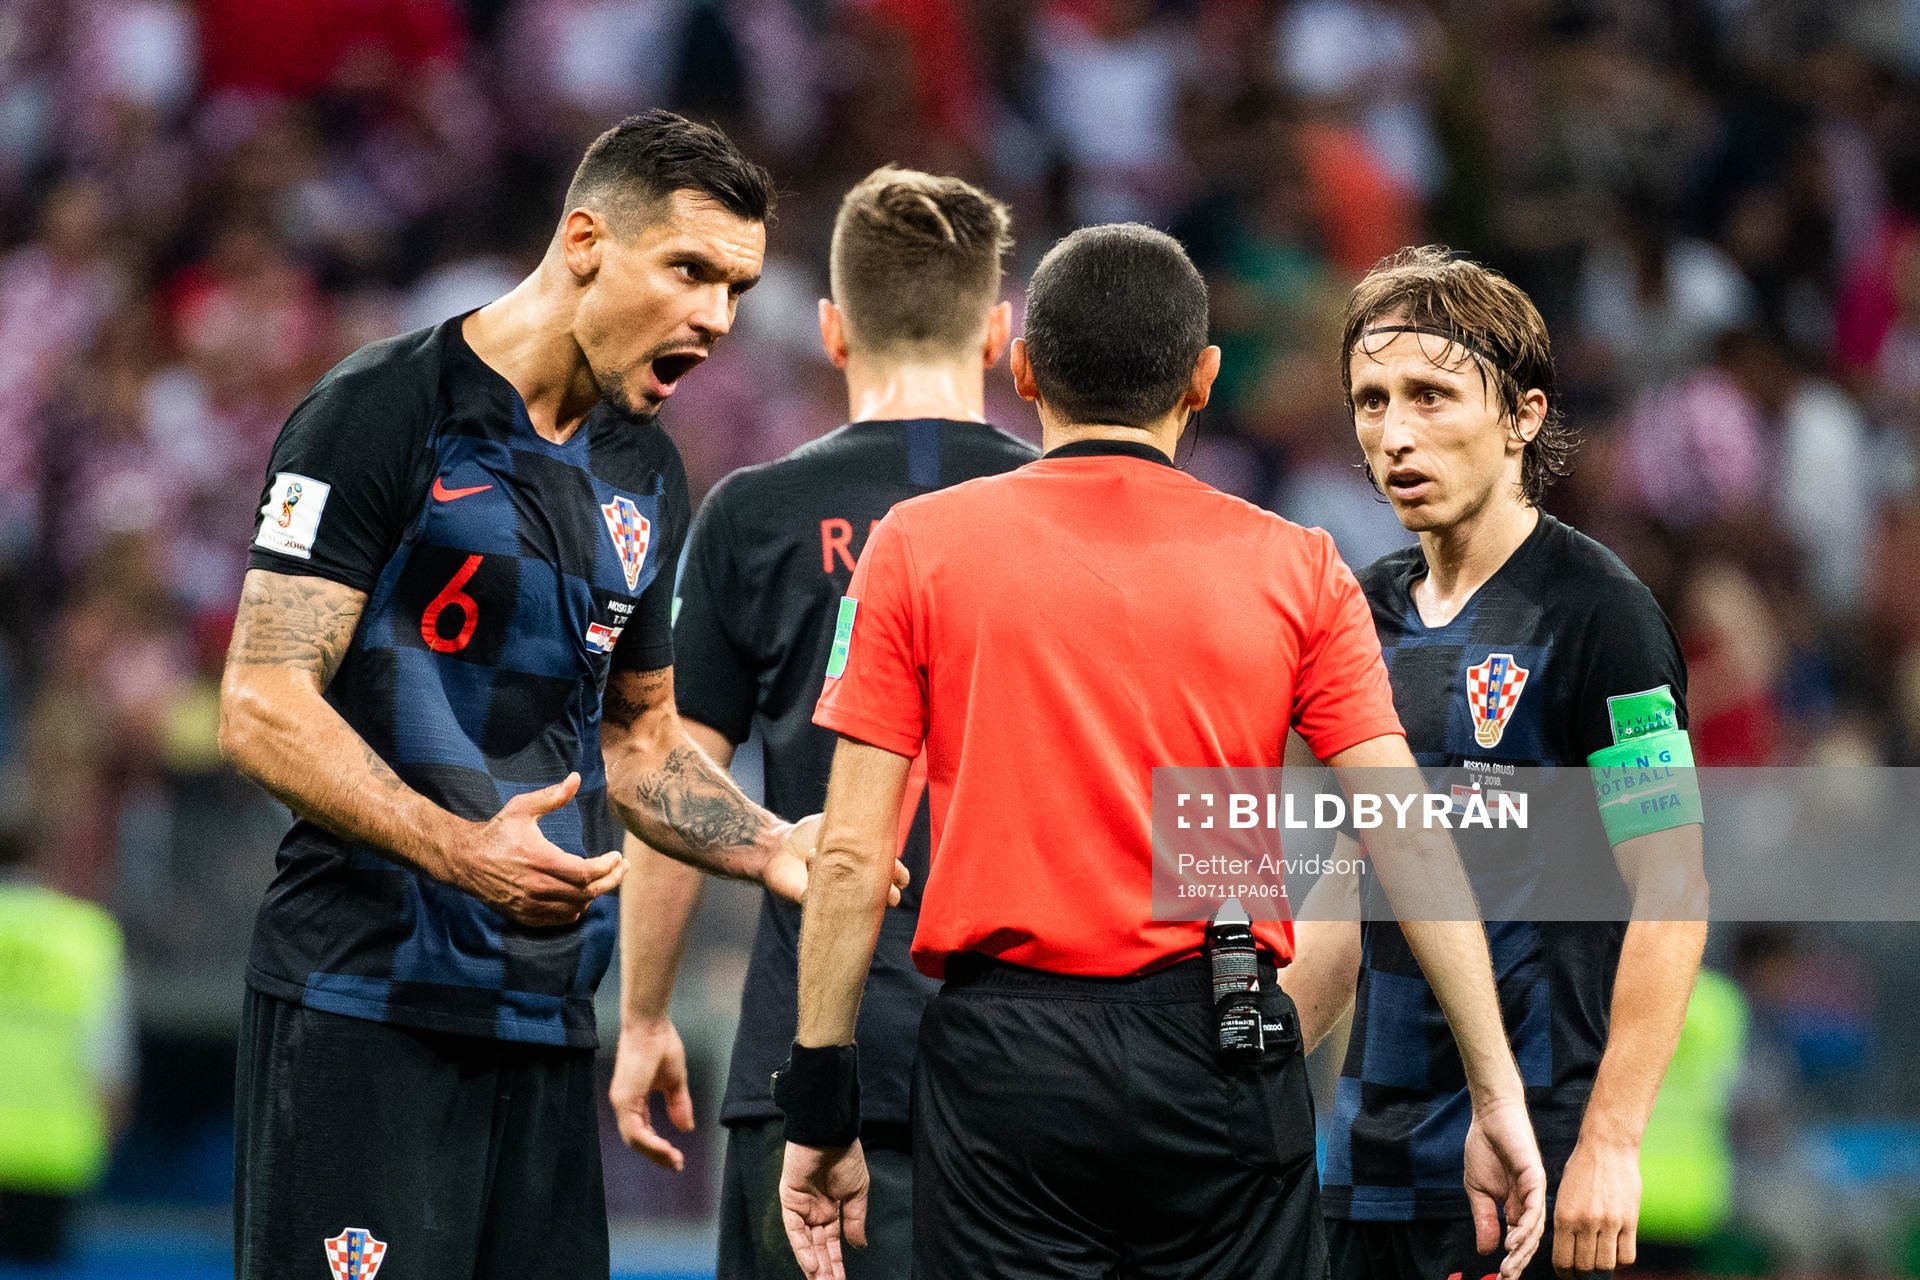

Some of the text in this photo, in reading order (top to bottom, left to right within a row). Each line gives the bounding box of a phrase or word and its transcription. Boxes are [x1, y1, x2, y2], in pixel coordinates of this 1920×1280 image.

[421, 555, 484, 653] 6
[1489, 664, 1503, 710] HNS
[1617, 708, 1671, 728] LIVING
[1492, 764, 1515, 776] (RUS)
[1593, 750, 1672, 784] VING
[1598, 766, 1676, 799] OTBALL
[1640, 793, 1681, 815] FIFA
